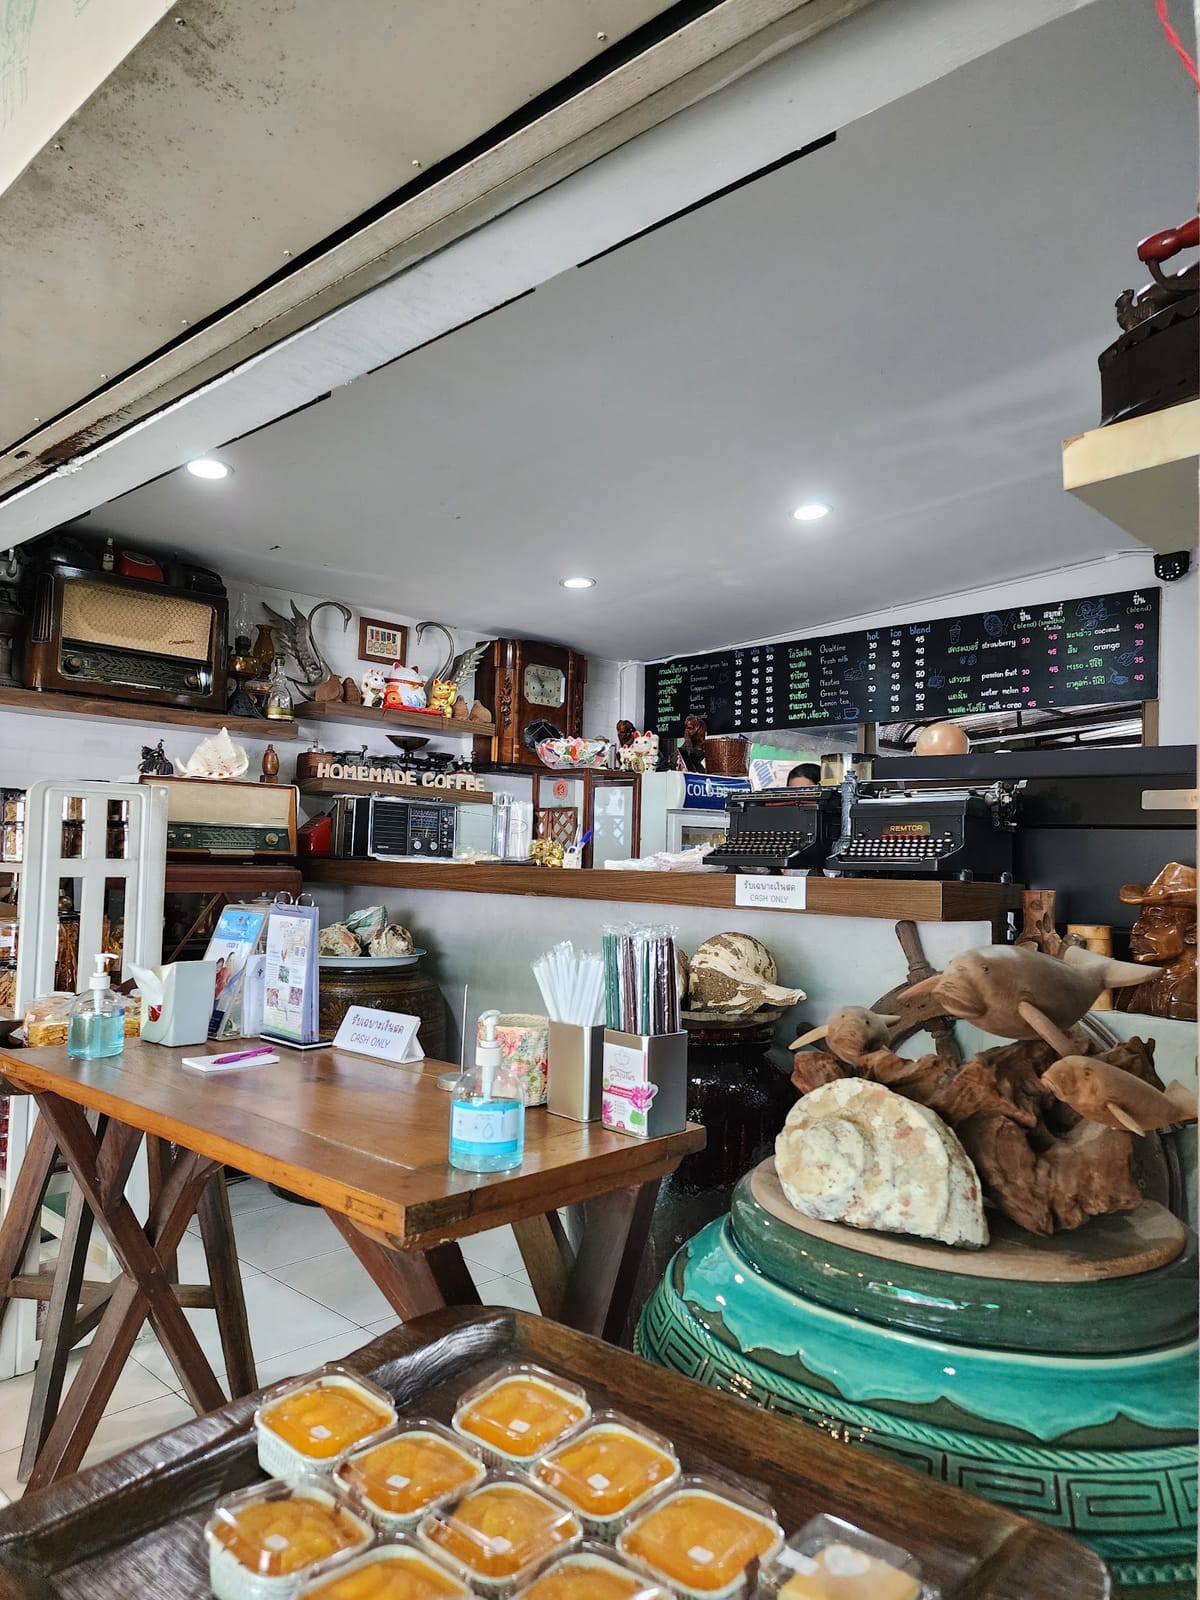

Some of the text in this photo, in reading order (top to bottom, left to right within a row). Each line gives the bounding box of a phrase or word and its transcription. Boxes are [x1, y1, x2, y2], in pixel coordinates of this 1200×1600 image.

[866, 624, 930, 641] hot ice blend
[820, 644, 846, 654] Ovaltine
[868, 642, 877, 650] 30
[915, 636, 925, 644] 45
[982, 639, 1016, 649] strawberry
[1093, 642, 1120, 651] orange
[752, 655, 759, 663] 45
[868, 652, 876, 660] 25
[891, 650, 900, 658] 35
[916, 647, 925, 655] 40
[891, 661, 900, 669] 40
[915, 658, 925, 667] 45
[766, 666, 773, 674] 50
[891, 672, 900, 680] 45
[916, 670, 925, 678] 50
[981, 672, 1003, 681] passion
[1005, 669, 1018, 677] fruit
[820, 689, 838, 698] Green
[868, 685, 876, 693] 30
[891, 683, 900, 691] 40
[914, 681, 924, 689] 45
[981, 688, 998, 697] water
[820, 699, 838, 708] Lemon
[890, 694, 899, 702] 45
[916, 692, 925, 701] 50
[989, 701, 1001, 710] milk
[891, 704, 900, 714] 30
[915, 703, 924, 712] 35
[317, 762, 485, 792] HOMEMADE COFFEE
[750, 894, 789, 903] CASH ONLY
[350, 1033, 391, 1048] CASH ONLY
